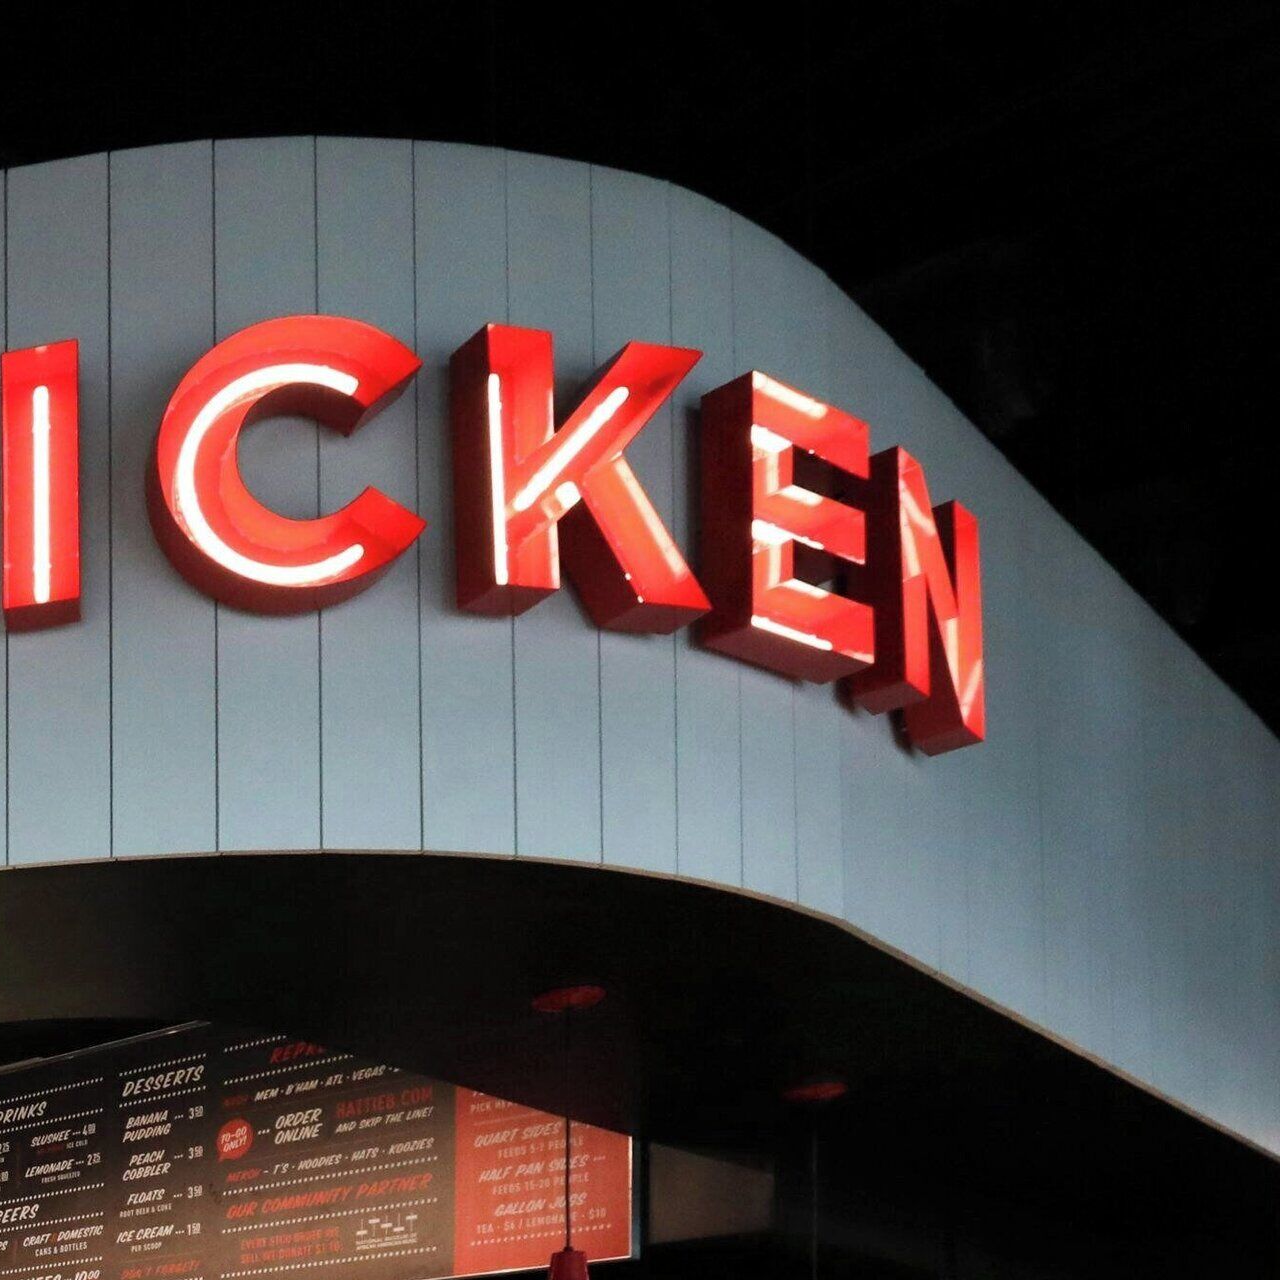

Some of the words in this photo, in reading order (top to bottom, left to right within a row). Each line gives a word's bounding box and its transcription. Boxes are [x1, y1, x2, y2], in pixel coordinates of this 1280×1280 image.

[122, 1065, 204, 1097] DESSERTS
[254, 1088, 278, 1102] MEM
[352, 1064, 386, 1081] VEGAS
[126, 1110, 168, 1129] BANANA
[275, 1108, 323, 1130] ORDER
[335, 1123, 356, 1134] AND
[385, 1111, 404, 1124] THE
[406, 1106, 433, 1120] LINE!
[30, 1129, 71, 1147] SLUSHEE
[122, 1123, 172, 1143] PUDDING
[274, 1123, 323, 1144] ONLINE
[129, 1150, 165, 1166] PEACH
[298, 1153, 342, 1171] HOODIES
[351, 1147, 379, 1162] HATS
[389, 1138, 434, 1155] KOOZIES
[25, 1159, 75, 1178] LEMONADE
[122, 1162, 171, 1181] COBBLER
[478, 1166, 512, 1183] HALF
[515, 1162, 545, 1176] PAN
[127, 1189, 165, 1205] FLOATS
[262, 1185, 353, 1214] COMMUNITY
[355, 1173, 433, 1199] PARTNER
[23, 1233, 52, 1247] CRAFT
[57, 1225, 103, 1241] DOMESTIC
[116, 1230, 135, 1243] ICE
[136, 1224, 174, 1240] CREAM
